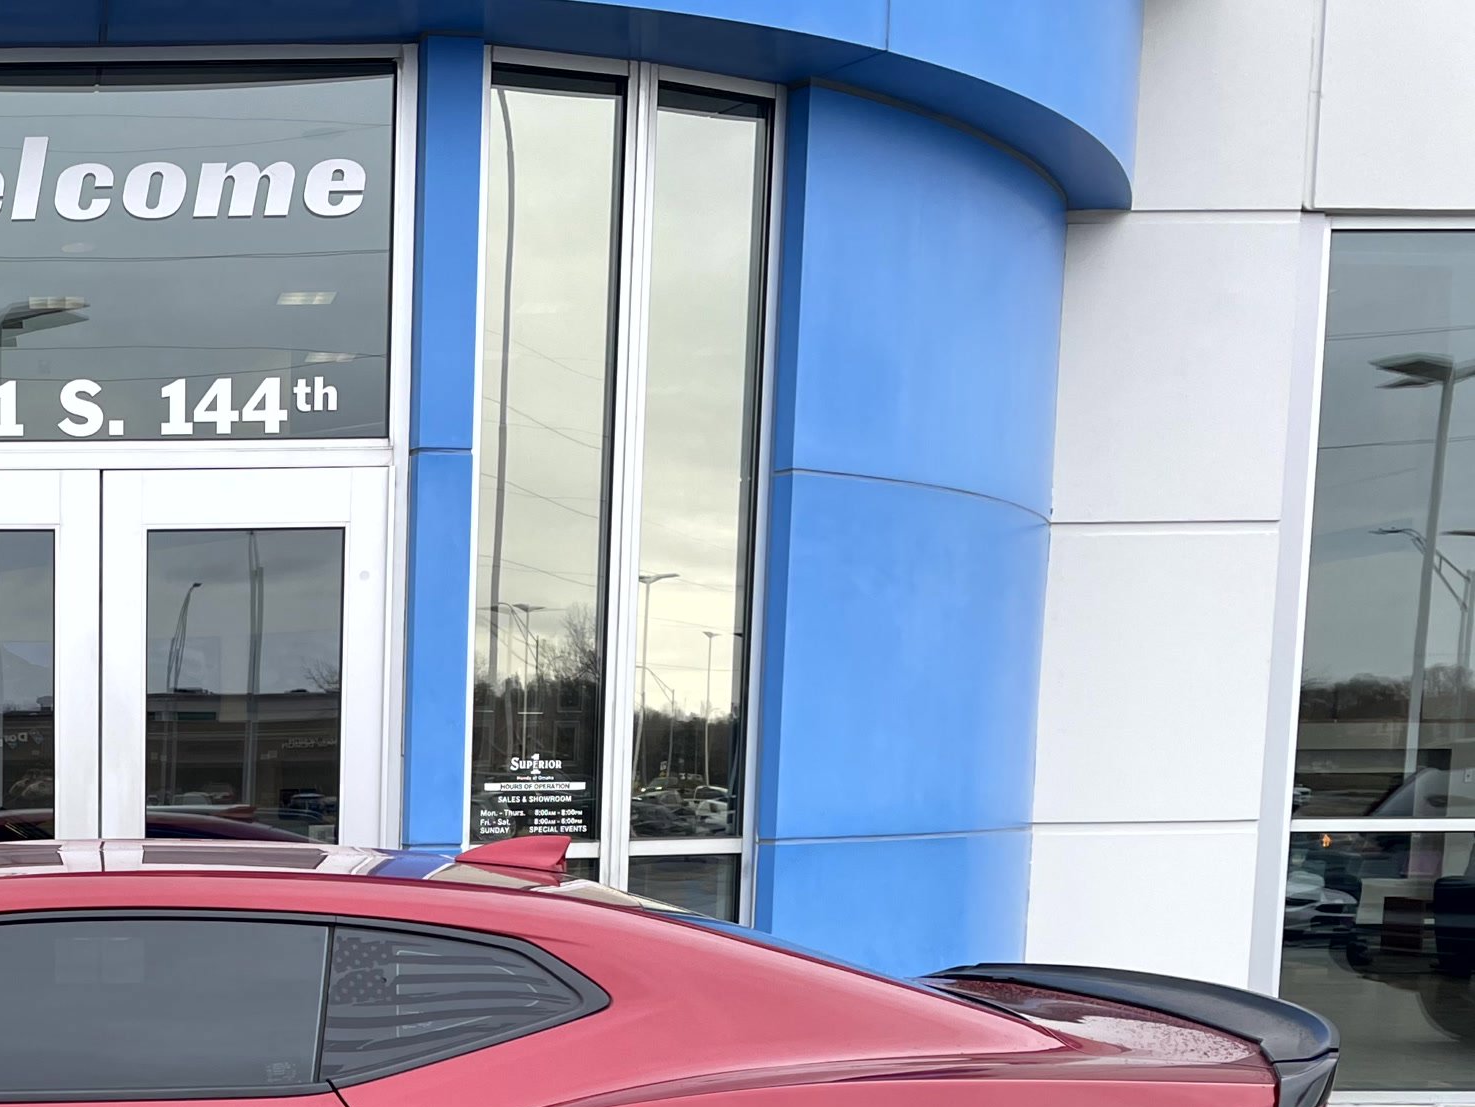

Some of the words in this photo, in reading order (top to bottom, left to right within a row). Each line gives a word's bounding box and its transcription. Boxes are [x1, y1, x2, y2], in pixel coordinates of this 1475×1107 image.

[57, 379, 124, 437] S.
[160, 376, 338, 436] 144th
[510, 757, 562, 771] SUPERIOR
[528, 795, 572, 803] SHOWROOM
[504, 809, 526, 817] Thurs.
[497, 818, 511, 826] Sat.
[560, 825, 587, 833] EVENTS
